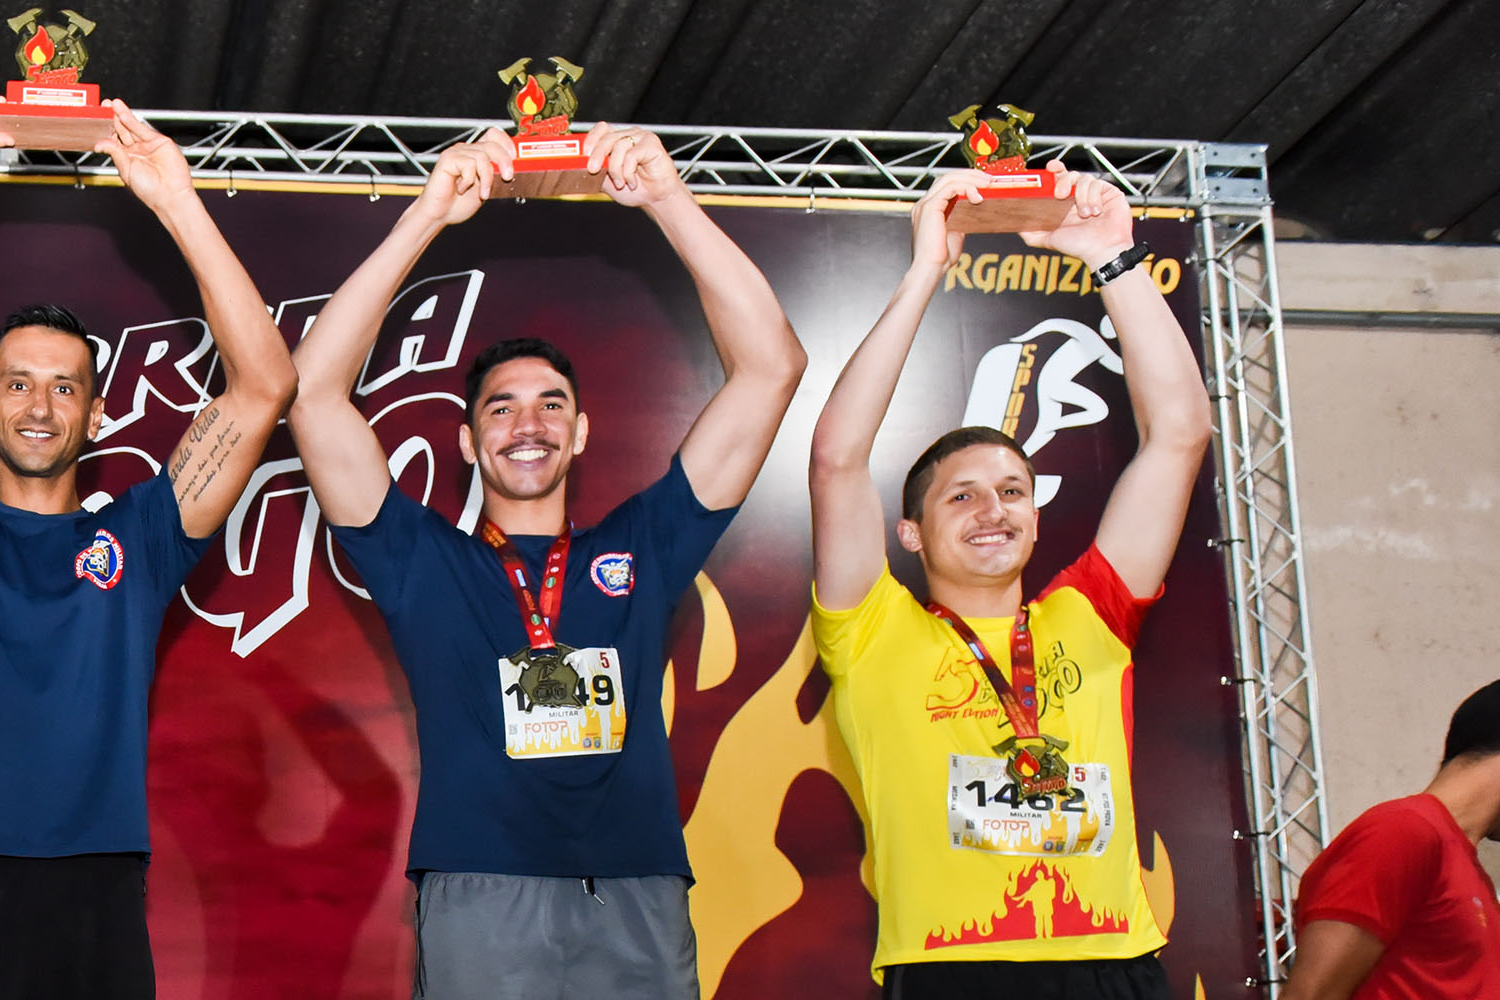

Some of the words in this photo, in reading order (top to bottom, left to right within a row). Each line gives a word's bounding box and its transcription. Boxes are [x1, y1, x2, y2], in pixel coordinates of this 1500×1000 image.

[945, 252, 1182, 297] RGANIZO
[1000, 343, 1038, 439] SPOR
[188, 407, 220, 444] Vidas
[600, 652, 610, 669] 5
[549, 710, 580, 718] MILITAR
[524, 720, 568, 734] FOTOP
[1074, 766, 1086, 782] 5
[965, 780, 1087, 813] 1462
[1010, 811, 1043, 819] MILITAR
[983, 819, 1030, 831] FOTOP
